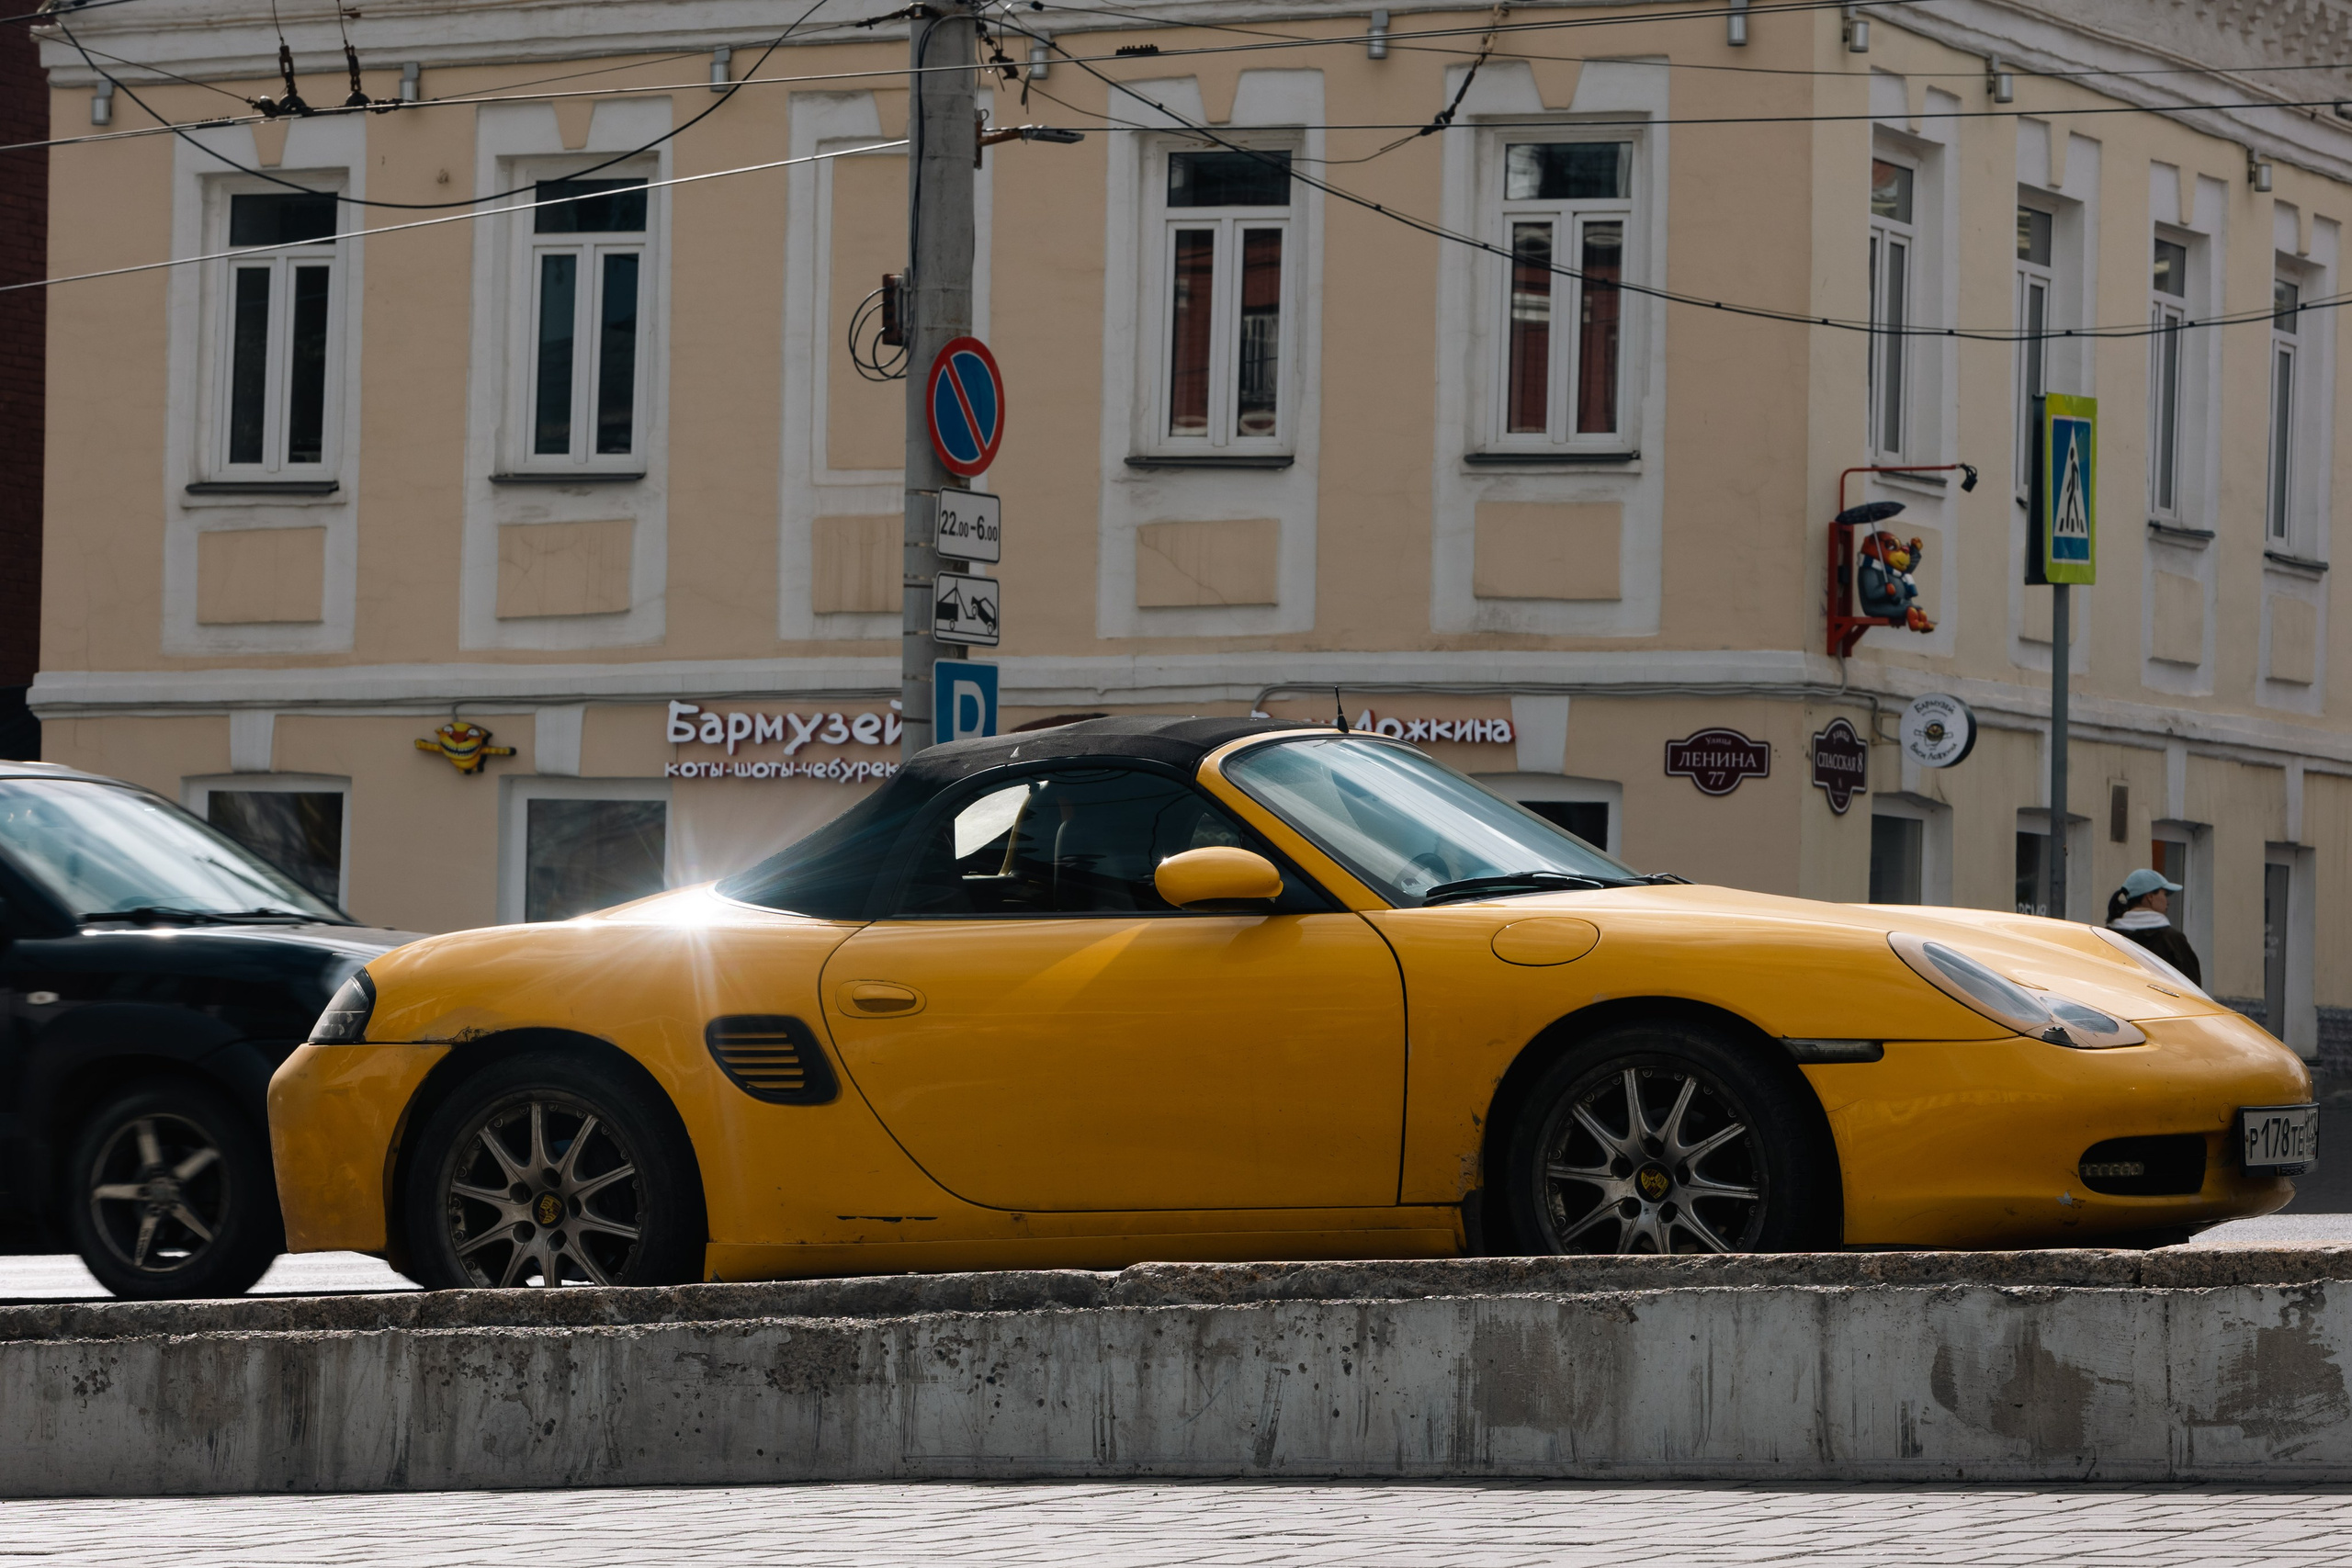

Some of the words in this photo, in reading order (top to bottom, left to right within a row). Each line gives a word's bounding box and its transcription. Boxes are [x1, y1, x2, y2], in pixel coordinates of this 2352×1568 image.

[667, 699, 902, 756] Бармузей
[1678, 750, 1758, 768] ЛЕНИНА
[1816, 751, 1856, 773] СПАССКАЯ
[1857, 751, 1864, 773] 8
[664, 757, 900, 784] коты-шоты-чебурек
[1707, 771, 1726, 786] 77
